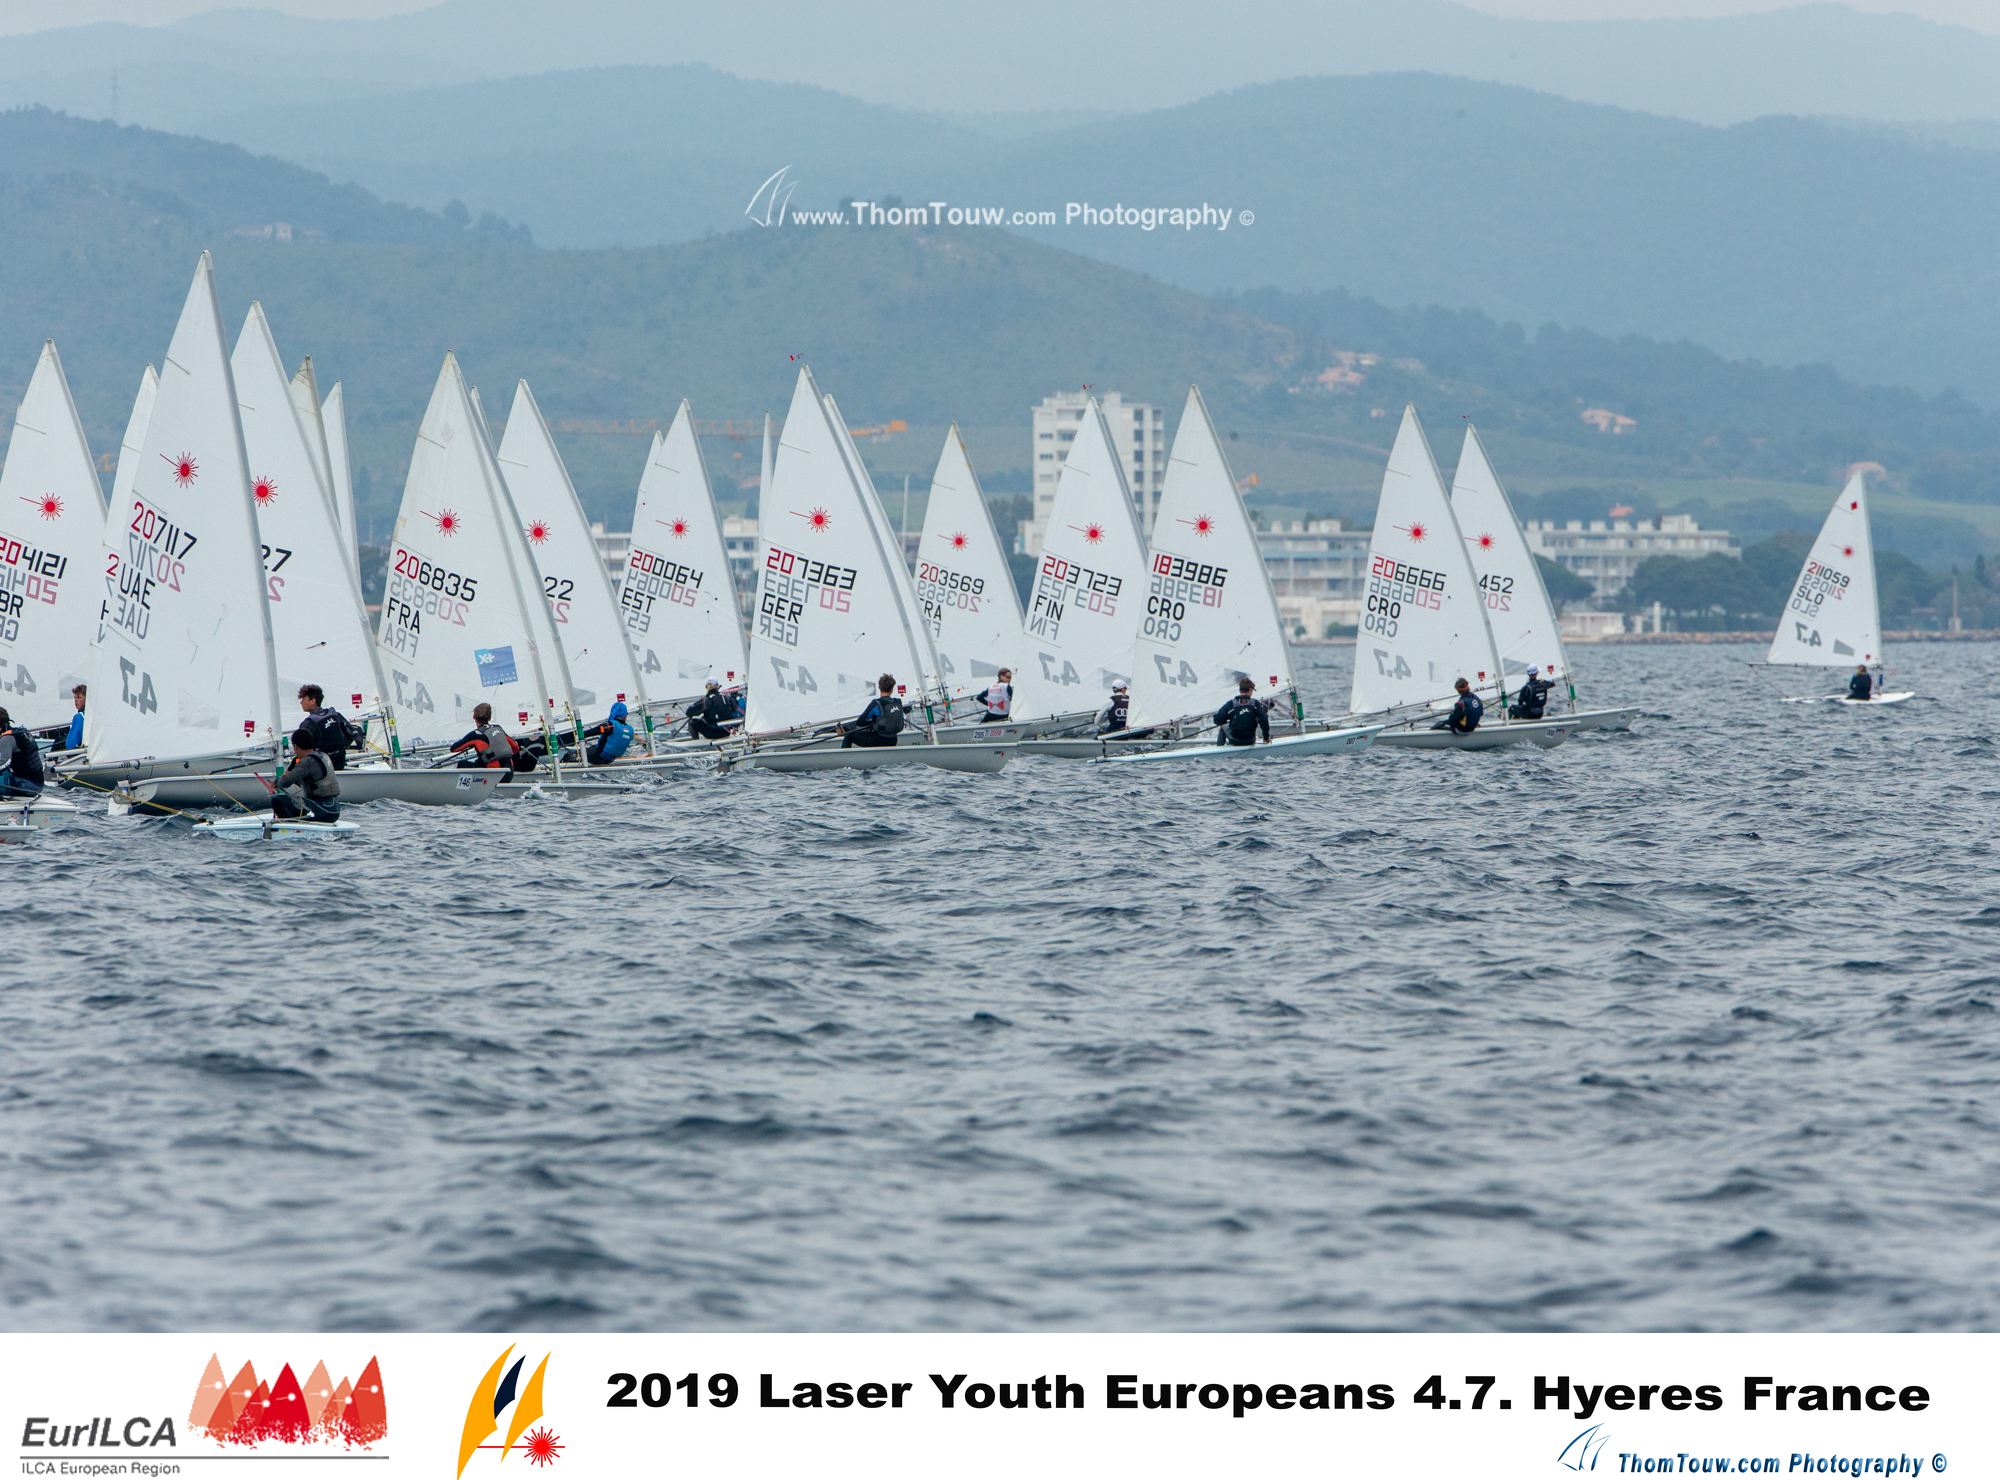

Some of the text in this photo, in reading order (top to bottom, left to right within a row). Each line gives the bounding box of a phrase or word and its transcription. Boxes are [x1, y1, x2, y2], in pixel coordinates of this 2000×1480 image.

[130, 501, 198, 560] 207117
[394, 548, 478, 602] 206835
[630, 549, 704, 589] 200064
[767, 547, 857, 590] 207363
[919, 562, 985, 595] 203569
[1042, 555, 1122, 597] 203723
[1153, 553, 1228, 587] 183986
[1372, 556, 1446, 591] 206666
[1807, 561, 1850, 588] 211059
[120, 563, 156, 610] UAE
[621, 587, 656, 613] EST
[1796, 585, 1824, 606] SLO
[386, 597, 421, 635] FRA
[761, 592, 804, 624] GER
[919, 598, 942, 621] RA
[1034, 595, 1064, 621] FIN
[1147, 596, 1185, 621] CRO
[1367, 594, 1400, 619] CRO
[458, 776, 471, 787] 146
